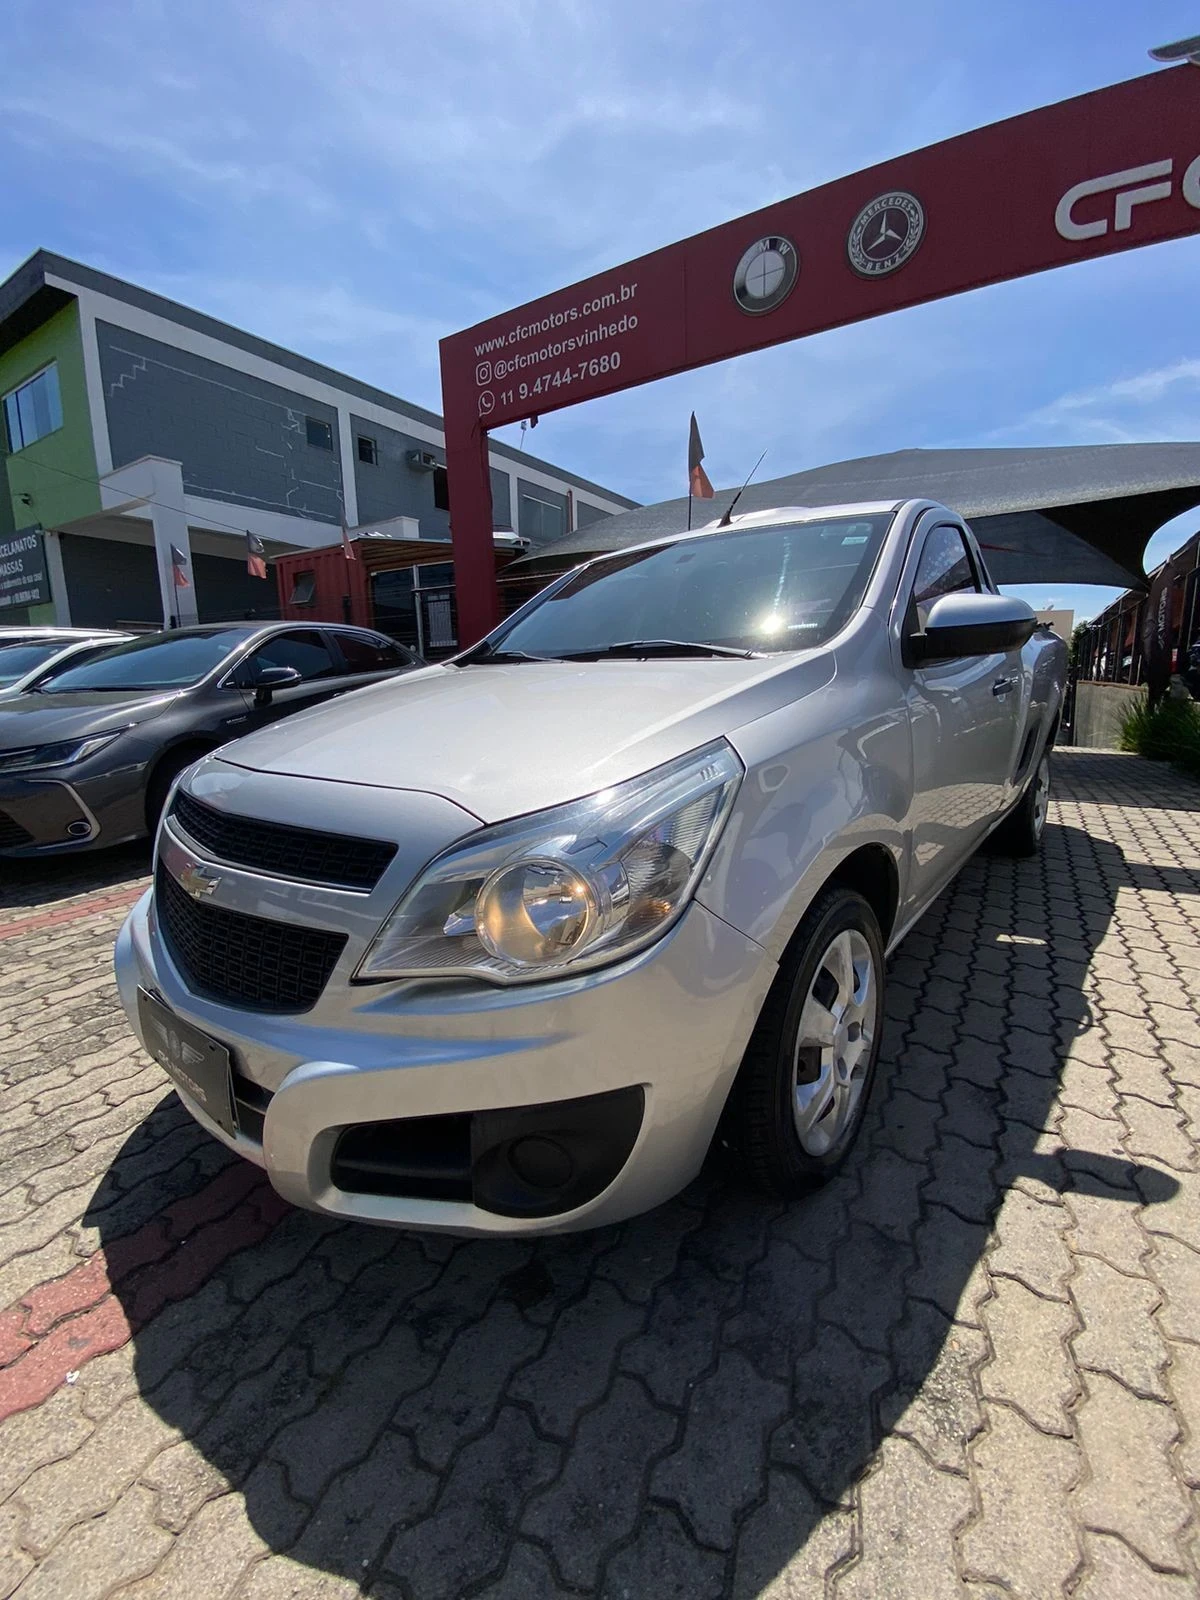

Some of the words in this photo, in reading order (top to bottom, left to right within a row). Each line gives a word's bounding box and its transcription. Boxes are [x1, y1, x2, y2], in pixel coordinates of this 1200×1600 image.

[860, 197, 913, 226] MERCEDES
[865, 255, 901, 272] BENZ
[474, 282, 638, 357] www.cfcmotors.com.br
[494, 314, 639, 380] @cfcmotorsvinhedo
[501, 390, 514, 406] 11
[518, 351, 621, 400] 9.4744-7680
[0, 534, 37, 558] CELANATOS
